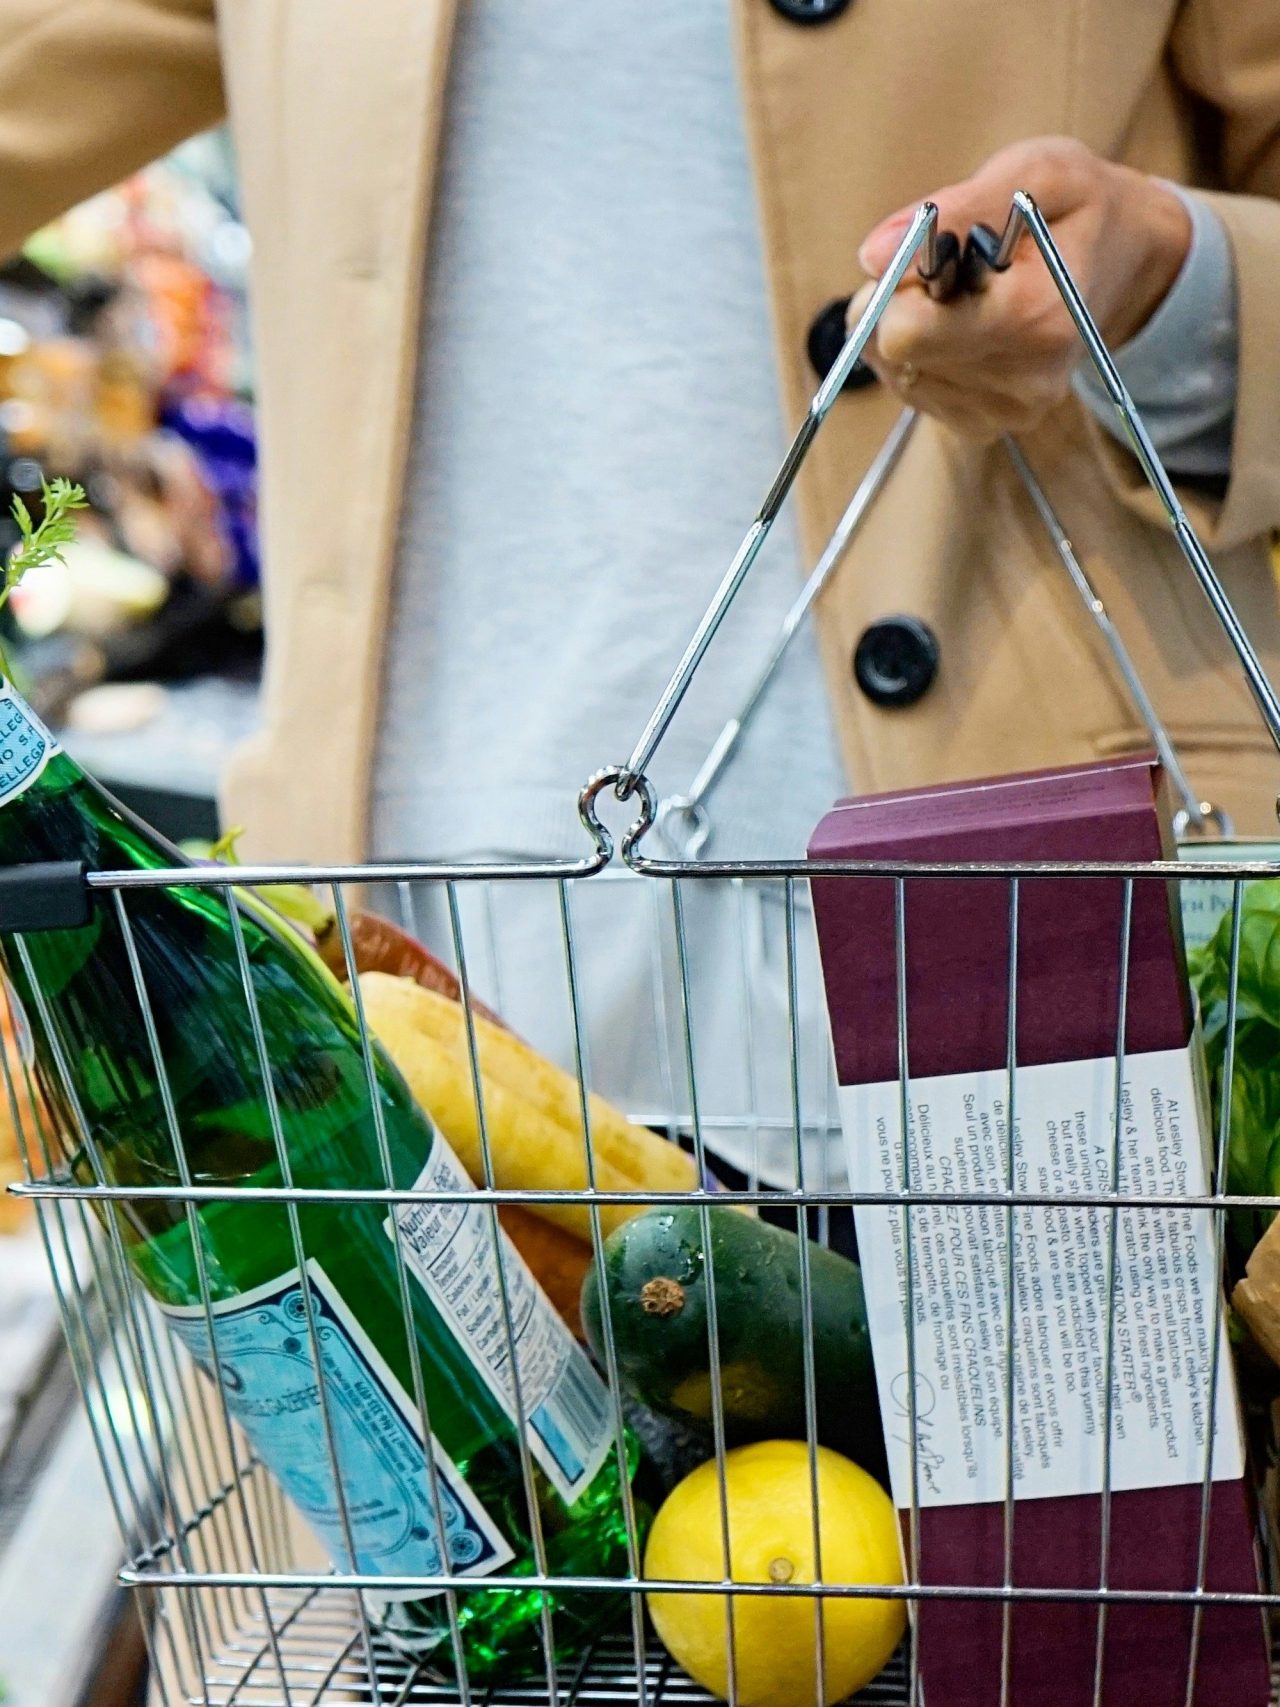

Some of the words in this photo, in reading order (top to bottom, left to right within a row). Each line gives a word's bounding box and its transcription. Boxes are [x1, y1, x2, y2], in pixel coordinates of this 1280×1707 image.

[961, 1093, 976, 1122] Seul
[992, 1099, 1005, 1115] de
[1149, 1087, 1168, 1142] delicious
[1165, 1098, 1179, 1112] At
[875, 1116, 887, 1146] vous
[916, 1103, 935, 1160] Délicieux
[966, 1124, 976, 1141] un
[979, 1112, 991, 1141] avec
[1060, 1119, 1074, 1139] but
[1074, 1110, 1090, 1145] these
[1125, 1125, 1137, 1135] &
[1165, 1116, 1184, 1156] Lesley
[879, 1149, 890, 1165] ne
[1045, 1119, 1062, 1166] cheese
[1093, 1144, 1105, 1154] A
[1127, 1138, 1141, 1159] her
[902, 1128, 925, 1214] accompags
[925, 1163, 936, 1180] au
[965, 1144, 985, 1188] produit
[982, 1144, 999, 1174] soin,
[1060, 1142, 1079, 1175] really
[1076, 1149, 1096, 1191] unique
[1144, 1155, 1155, 1176] are
[1157, 1145, 1172, 1176] food.
[938, 1155, 959, 1224] CRAEZ
[988, 1177, 999, 1193] en
[1015, 1161, 1031, 1193] Stow
[1036, 1166, 1049, 1194] snac
[1052, 1168, 1062, 1182] or
[1130, 1162, 1145, 1194] team
[926, 1183, 945, 1229] nurel,
[975, 1190, 992, 1235] aison
[1118, 1184, 1133, 1213] fr
[1147, 1180, 1160, 1215] me
[1162, 1180, 1178, 1218] The
[917, 1217, 930, 1233] de
[959, 1205, 979, 1250] pouvait
[992, 1204, 1007, 1238] etites
[1051, 1185, 1072, 1244] apasto.
[1087, 1206, 1104, 1247] ackers
[1136, 1206, 1150, 1229] ink
[1180, 1207, 1194, 1231] ine
[410, 1215, 443, 1254] Valeur
[886, 1218, 904, 1245] plus
[934, 1232, 946, 1254] ces
[1046, 1236, 1058, 1246] &
[1074, 1215, 1089, 1249] when
[1122, 1215, 1140, 1262] scratch
[1139, 1232, 1153, 1253] the
[1152, 1218, 1167, 1243] with
[948, 1225, 965, 1267] POUR
[1025, 1233, 1041, 1273] Foods
[1048, 1249, 1059, 1270] are
[1062, 1247, 1076, 1268] We
[1093, 1250, 1104, 1270] are
[1156, 1246, 1168, 1274] care
[1167, 1221, 1185, 1273] fabulous
[1184, 1234, 1200, 1273] Foods
[893, 1248, 906, 1277] vous
[917, 1236, 939, 1298] trempette,
[978, 1238, 999, 1289] fabriqué
[1075, 1252, 1095, 1295] topped
[1139, 1254, 1157, 1281] only
[935, 1257, 958, 1321] craquelins
[954, 1270, 969, 1299] CES
[969, 1253, 988, 1308] satisfaire
[1014, 1260, 1032, 1312] fabuleux
[1031, 1275, 1047, 1311] adore
[1051, 1273, 1063, 1300] sure
[1066, 1271, 1077, 1292] are
[1126, 1264, 1144, 1298] using
[1160, 1277, 1173, 1289] in
[1172, 1276, 1191, 1314] crisps
[1189, 1277, 1200, 1295] we
[929, 1301, 942, 1318] de
[989, 1291, 1002, 1323] avec
[1085, 1297, 1099, 1323] with
[1134, 1300, 1145, 1320] our
[1143, 1285, 1158, 1308] way
[1162, 1292, 1178, 1326] small
[1192, 1298, 1207, 1324] love
[959, 1301, 974, 1335] FINS
[1052, 1304, 1067, 1327] you
[1069, 1295, 1087, 1348] addicted
[1150, 1312, 1162, 1325] to
[1180, 1316, 1195, 1345] from
[929, 1320, 950, 1371] fromage
[947, 1323, 961, 1350] sont
[974, 1311, 994, 1352] Lesley
[993, 1323, 1007, 1346] des
[1033, 1314, 1055, 1369] fabriquer
[1059, 1329, 1072, 1349] will
[1086, 1326, 1101, 1353] your
[1137, 1324, 1153, 1358] finest
[1152, 1327, 1168, 1362] make
[983, 1354, 995, 1367] et
[1019, 1315, 1042, 1379] craquelins
[1062, 1352, 1075, 1368] be
[1077, 1351, 1089, 1364] to
[1167, 1329, 1185, 1381] batches.
[1193, 1326, 1213, 1373] making
[939, 1374, 950, 1391] ou
[963, 1336, 987, 1427] CRAQUELINS
[985, 1370, 997, 1393] son
[1012, 1351, 1029, 1396] cuisine
[1044, 1372, 1056, 1385] et
[1064, 1371, 1078, 1393] too.
[1079, 1366, 1093, 1387] this
[1157, 1364, 1167, 1373] a
[1181, 1348, 1202, 1398] Lesley's
[951, 1353, 972, 1421] irrésistibles
[1031, 1382, 1045, 1409] sont
[1046, 1387, 1059, 1416] vous
[1139, 1360, 1162, 1430] ingredients.
[1156, 1376, 1174, 1409] great
[986, 1395, 1006, 1440] équipe.
[1019, 1398, 1032, 1414] de
[1079, 1391, 1097, 1437] yummy
[1051, 1419, 1066, 1448] offrir
[1115, 1413, 1127, 1439] own
[1160, 1411, 1181, 1458] product
[1191, 1400, 1208, 1446] kitchen
[958, 1424, 980, 1479] lorsqu'ils
[1032, 1411, 1054, 1469] fabriqués
